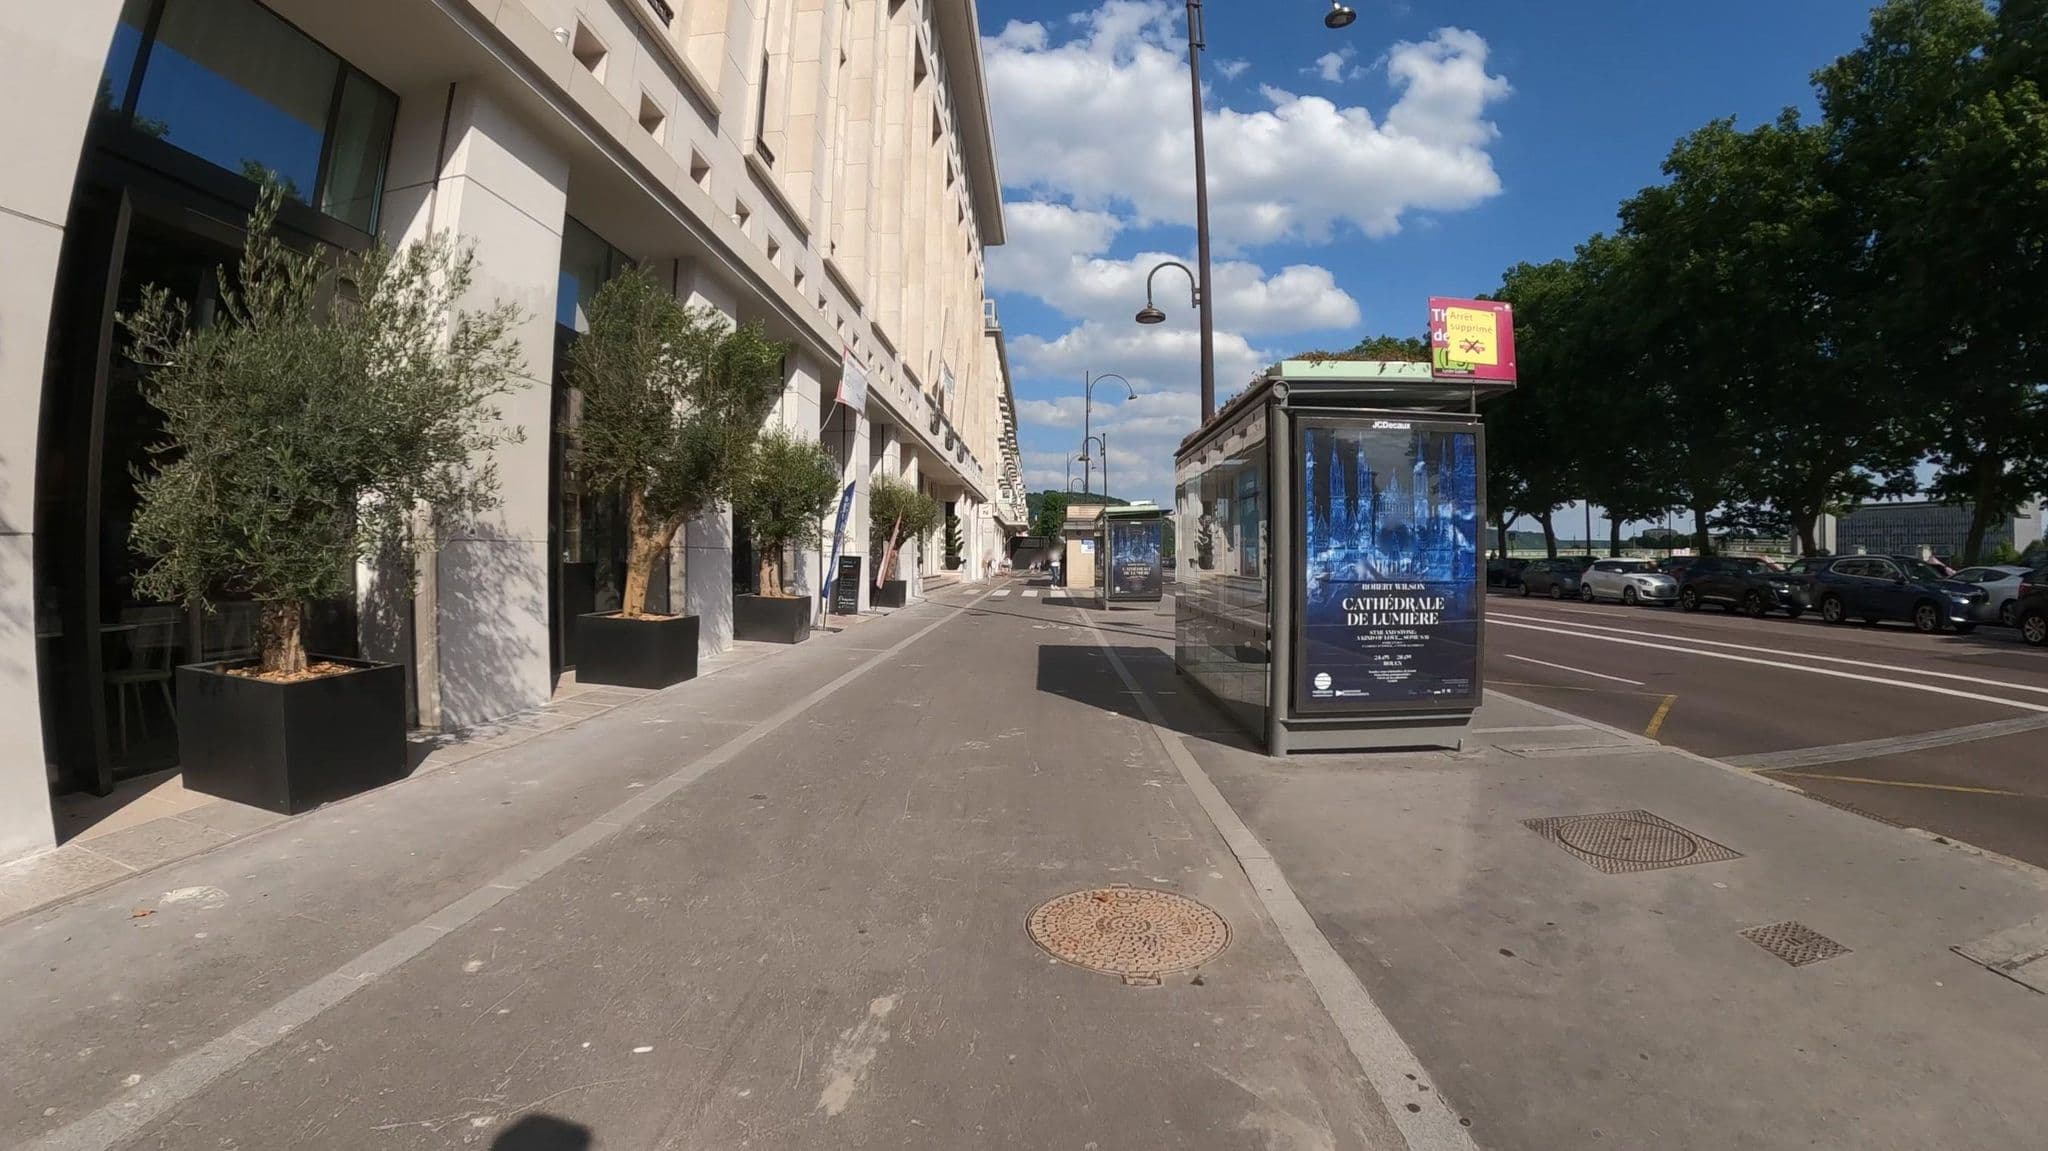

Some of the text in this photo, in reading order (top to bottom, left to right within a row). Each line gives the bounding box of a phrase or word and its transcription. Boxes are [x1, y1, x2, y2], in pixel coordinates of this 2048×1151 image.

[1372, 421, 1411, 429] JCDecaux
[1362, 583, 1426, 591] ROBERT WILSON
[1342, 594, 1445, 611] CATHÉDRALE
[1348, 613, 1369, 626] DE
